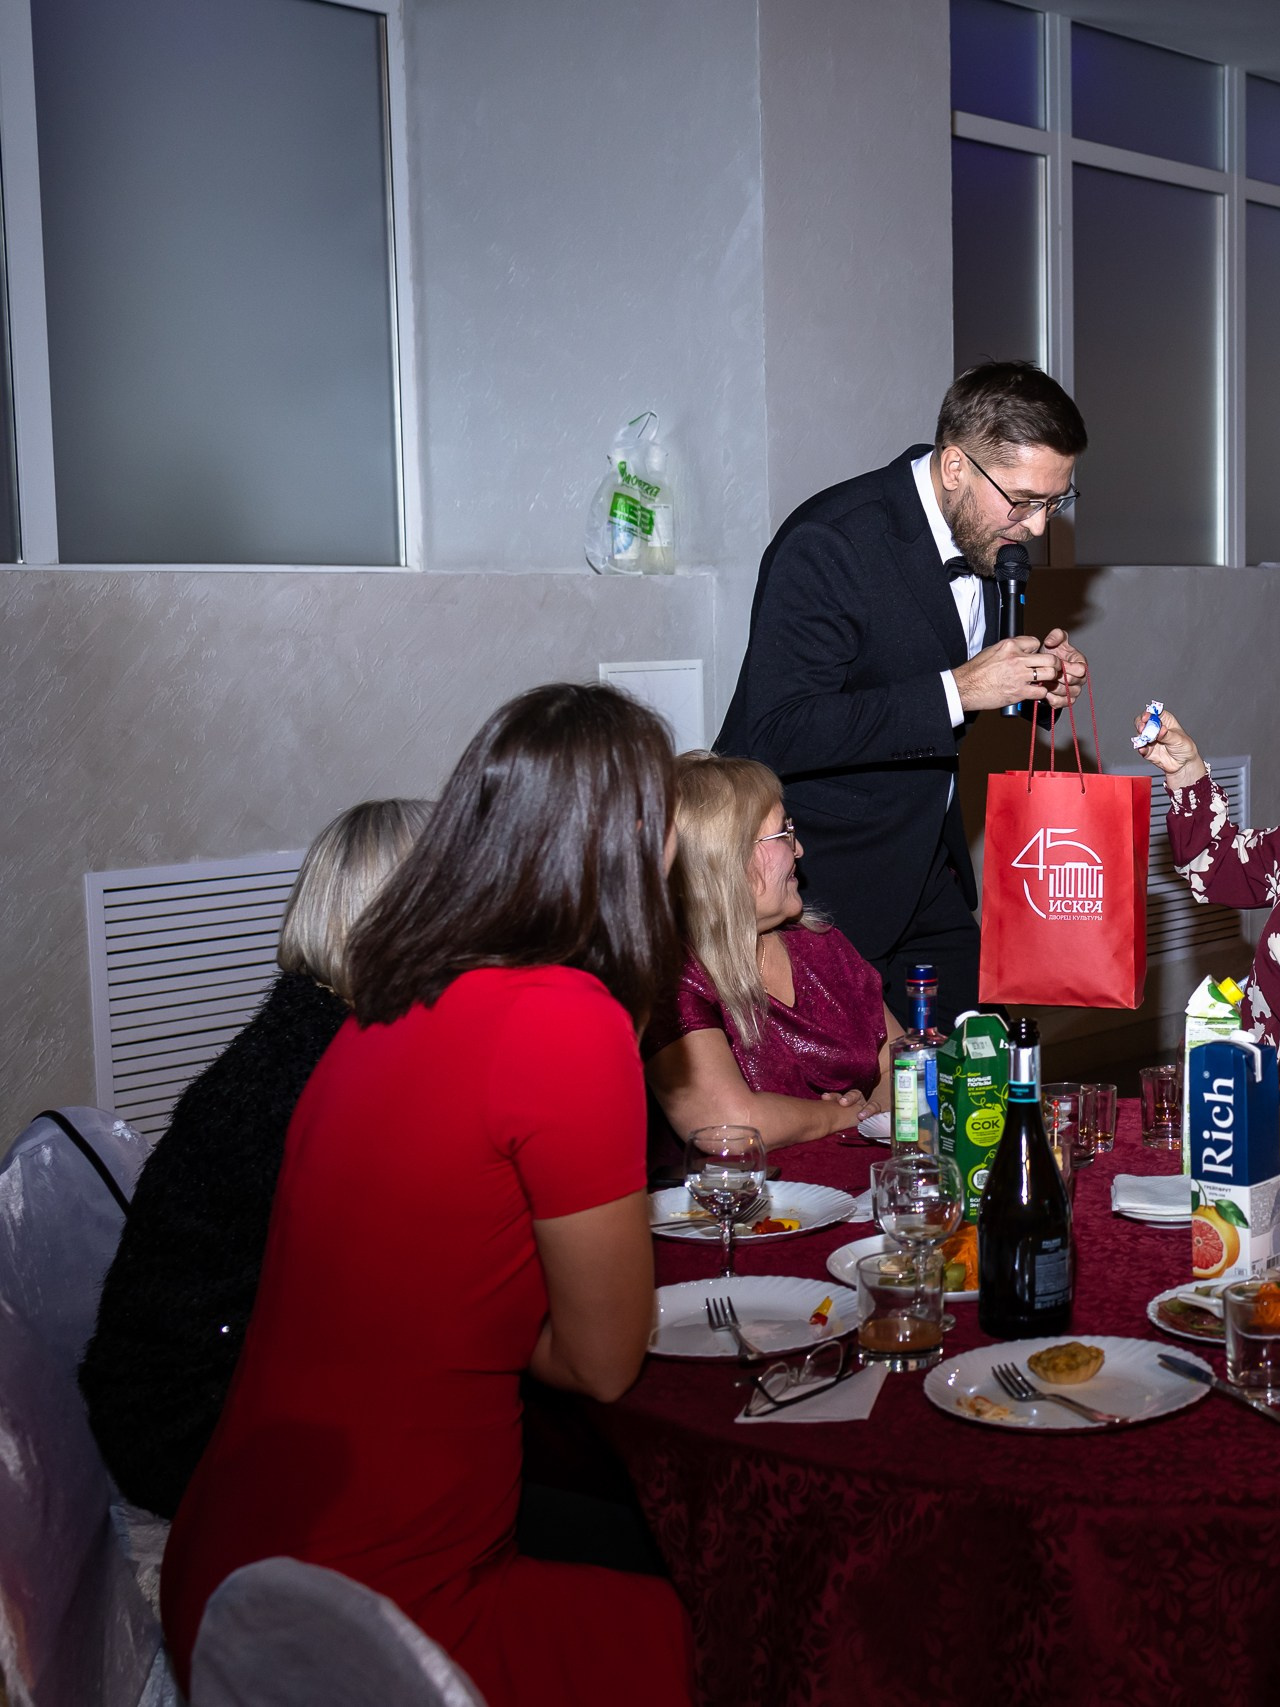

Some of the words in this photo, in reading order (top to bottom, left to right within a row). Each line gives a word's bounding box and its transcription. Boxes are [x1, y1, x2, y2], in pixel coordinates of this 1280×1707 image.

[1011, 828, 1102, 890] 45
[1048, 899, 1103, 913] ИСКРА
[971, 1119, 1000, 1131] СОК
[1202, 1076, 1235, 1178] Rich
